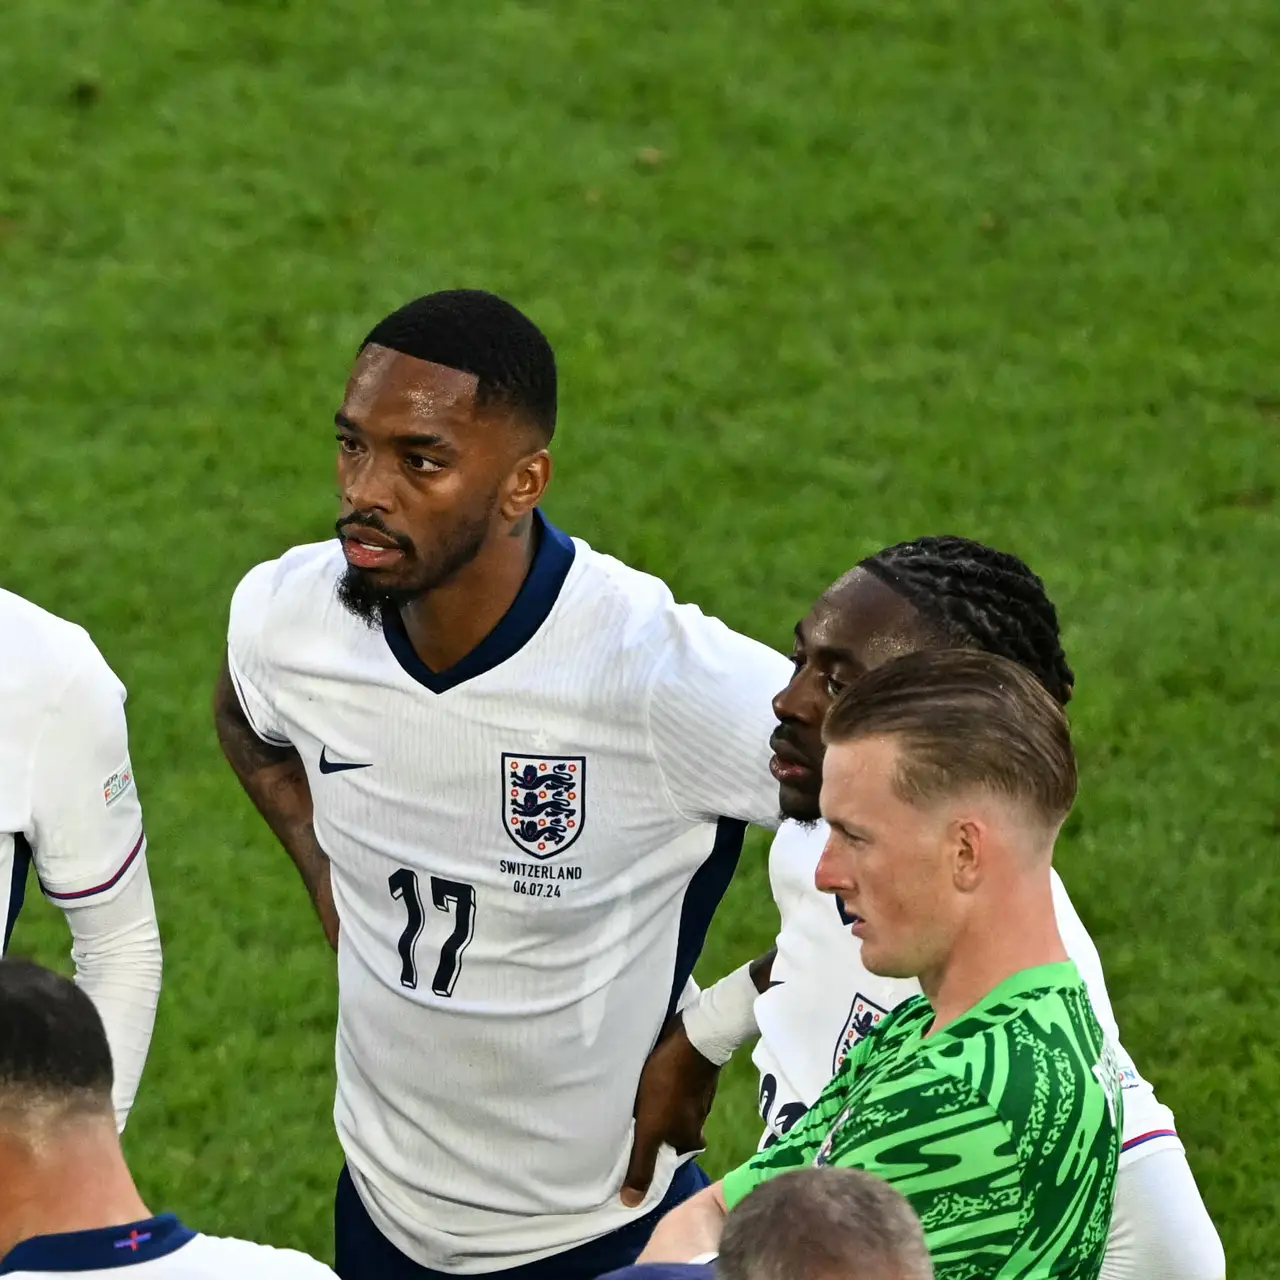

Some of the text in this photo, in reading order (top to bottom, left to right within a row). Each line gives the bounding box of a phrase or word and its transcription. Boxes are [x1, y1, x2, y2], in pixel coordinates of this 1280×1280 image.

[499, 859, 583, 880] SWITZERLAND
[513, 879, 562, 898] 06.07.24
[388, 868, 476, 998] 17
